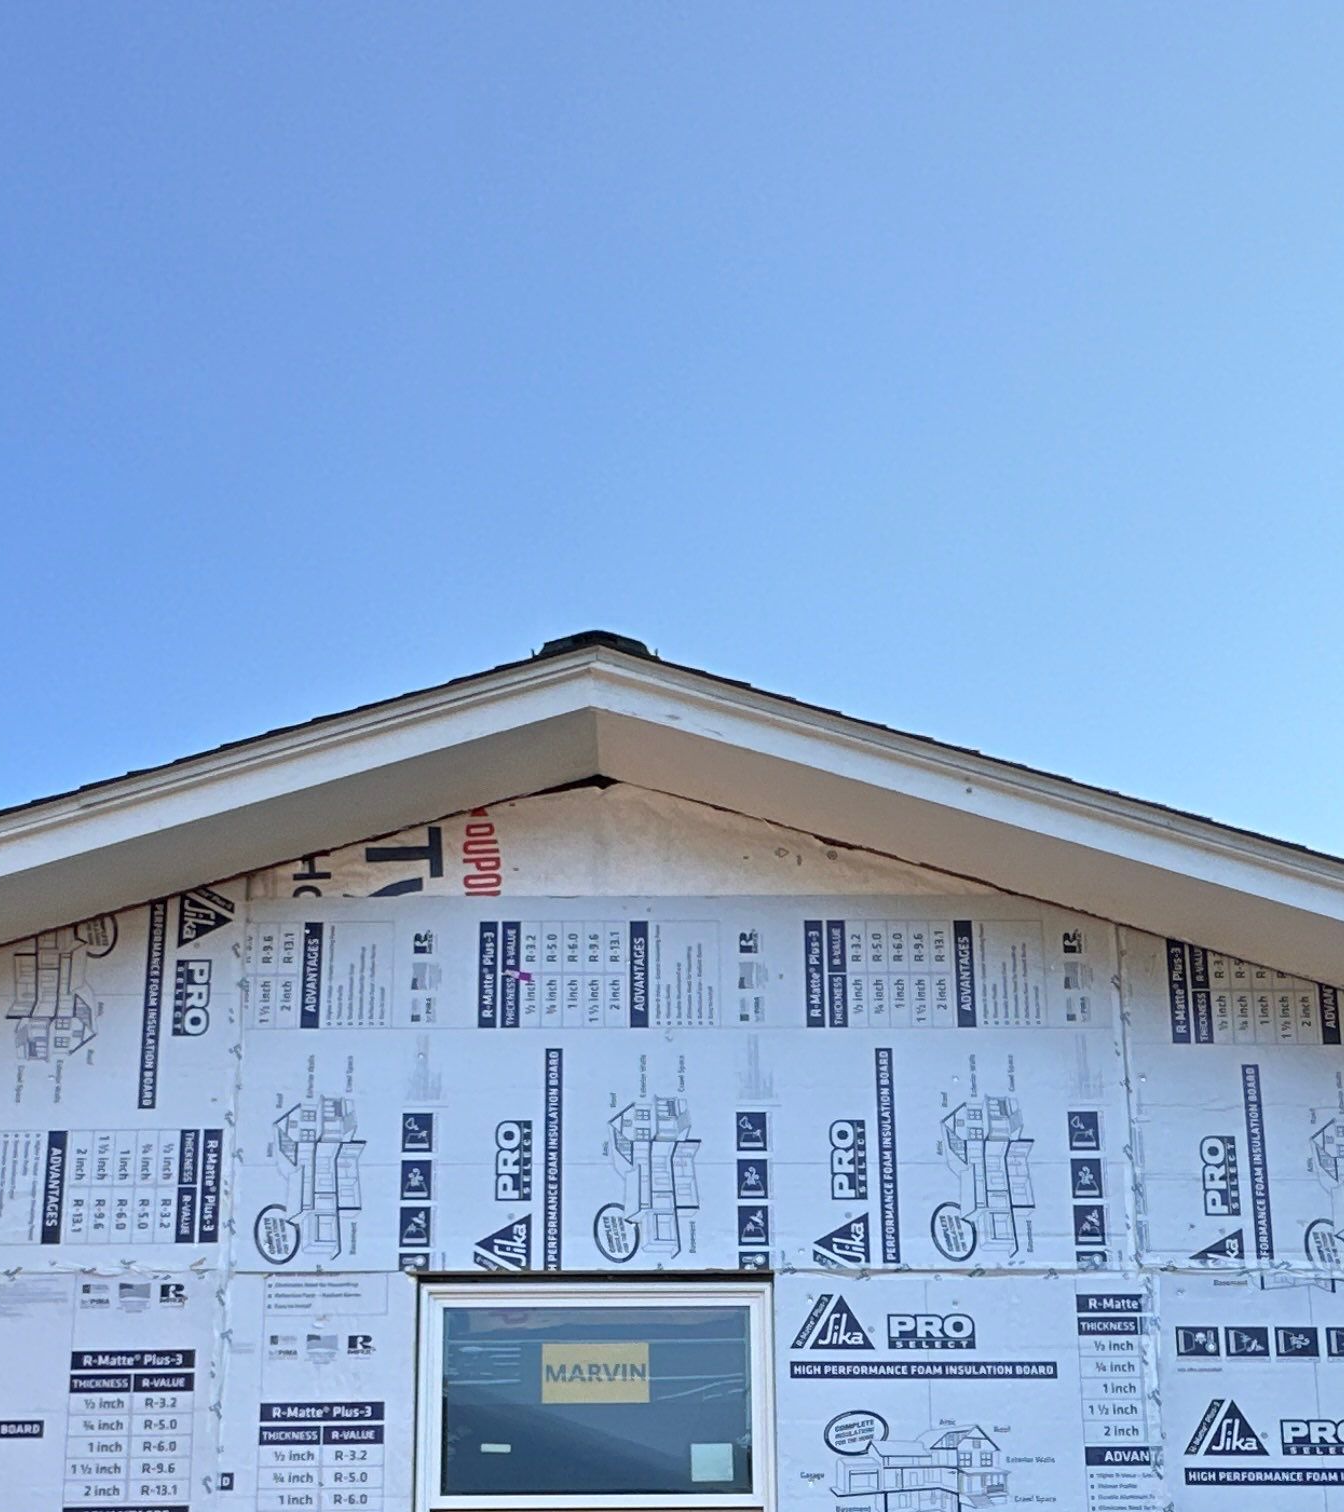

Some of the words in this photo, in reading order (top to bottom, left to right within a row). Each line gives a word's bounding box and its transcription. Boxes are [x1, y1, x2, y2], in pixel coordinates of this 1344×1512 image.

[463, 822, 502, 896] DUPO
[807, 930, 820, 965] Plus-3
[851, 934, 862, 962] R-3.2
[893, 933, 903, 962] R-6.0
[934, 931, 945, 962] R-13.1
[957, 936, 972, 1012] ADVANTAGES
[174, 967, 184, 1028] SELECT
[184, 962, 209, 1034] PRO
[878, 1051, 890, 1085] BOARD
[879, 1087, 892, 1148] INSULATION
[832, 1122, 855, 1198] PRO
[857, 1127, 866, 1193] SELECT
[882, 1150, 893, 1180] FOAM
[883, 1182, 896, 1260] PERFORMANCE
[817, 1313, 864, 1345] Sika
[890, 1316, 972, 1338] PRO
[896, 1340, 967, 1348] SELECT
[143, 1353, 183, 1366] Plus-3
[793, 1364, 821, 1374] HIGH
[824, 1364, 908, 1375] PERFORMANCE
[910, 1365, 942, 1375] FOAM
[945, 1365, 1012, 1375] INSULATION
[1015, 1365, 1054, 1375] BOARD
[545, 1363, 646, 1383] MARVIN
[99, 1398, 124, 1409] inch
[145, 1397, 177, 1408] R-3.2
[0, 1423, 40, 1435] BOARD
[98, 1420, 123, 1430] inch
[144, 1419, 177, 1430] R-5.0
[1211, 1418, 1258, 1451] Sika
[88, 1442, 92, 1452] 1
[97, 1442, 122, 1452] inch
[143, 1440, 176, 1452] R-6.0
[71, 1464, 76, 1474] 1
[96, 1463, 121, 1474] inch
[142, 1463, 175, 1473] R-9.6
[1188, 1471, 1216, 1481] HIGH
[1218, 1471, 1303, 1482] PERFORMANCE
[1306, 1471, 1338, 1482] FOAM
[84, 1486, 91, 1496] 2
[94, 1485, 120, 1496] inch
[140, 1484, 177, 1496] R-13.1
